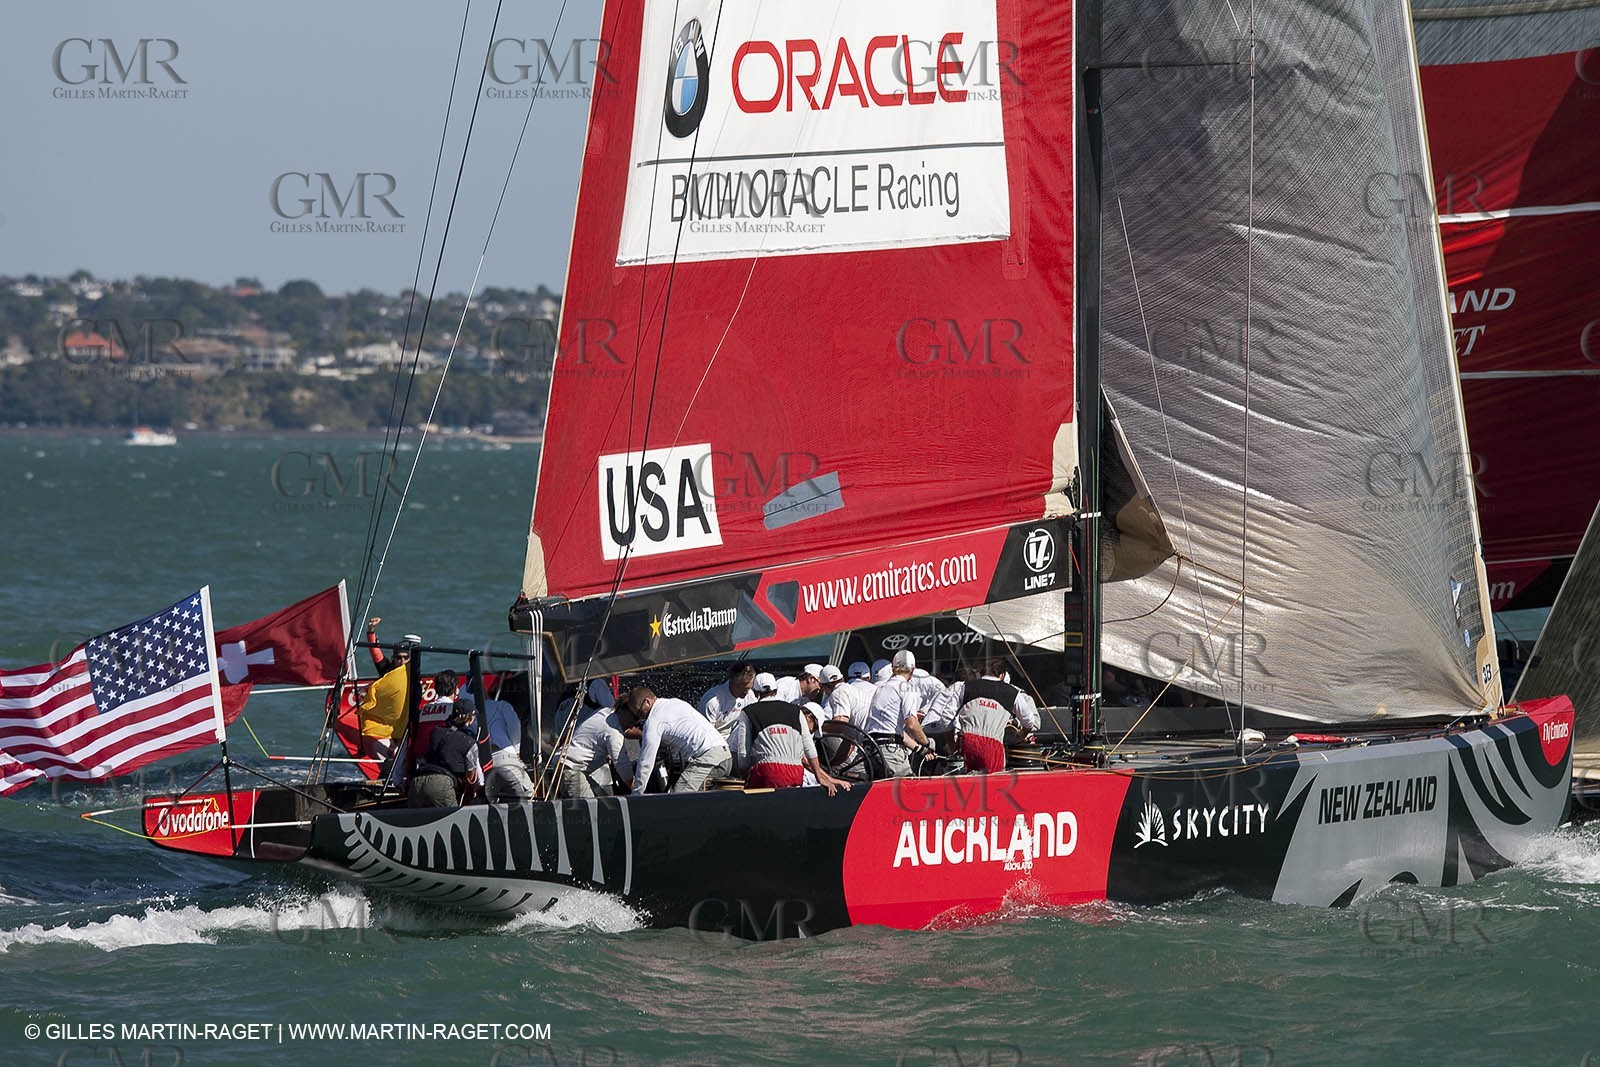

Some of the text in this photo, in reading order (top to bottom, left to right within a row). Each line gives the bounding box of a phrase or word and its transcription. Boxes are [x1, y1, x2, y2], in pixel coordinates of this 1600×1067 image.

[732, 32, 967, 113] ORACLE
[878, 161, 960, 217] Racing
[606, 459, 712, 546] USA
[803, 553, 977, 612] www.emirates.com
[913, 632, 984, 648] TOYOTA
[421, 704, 448, 717] SLAM
[979, 699, 998, 709] SLAM
[172, 806, 229, 833] vodafone
[1173, 802, 1270, 841] SKYCITY
[1318, 776, 1438, 825] NEW ZEALAND
[893, 811, 1078, 868] AUCKLAND
